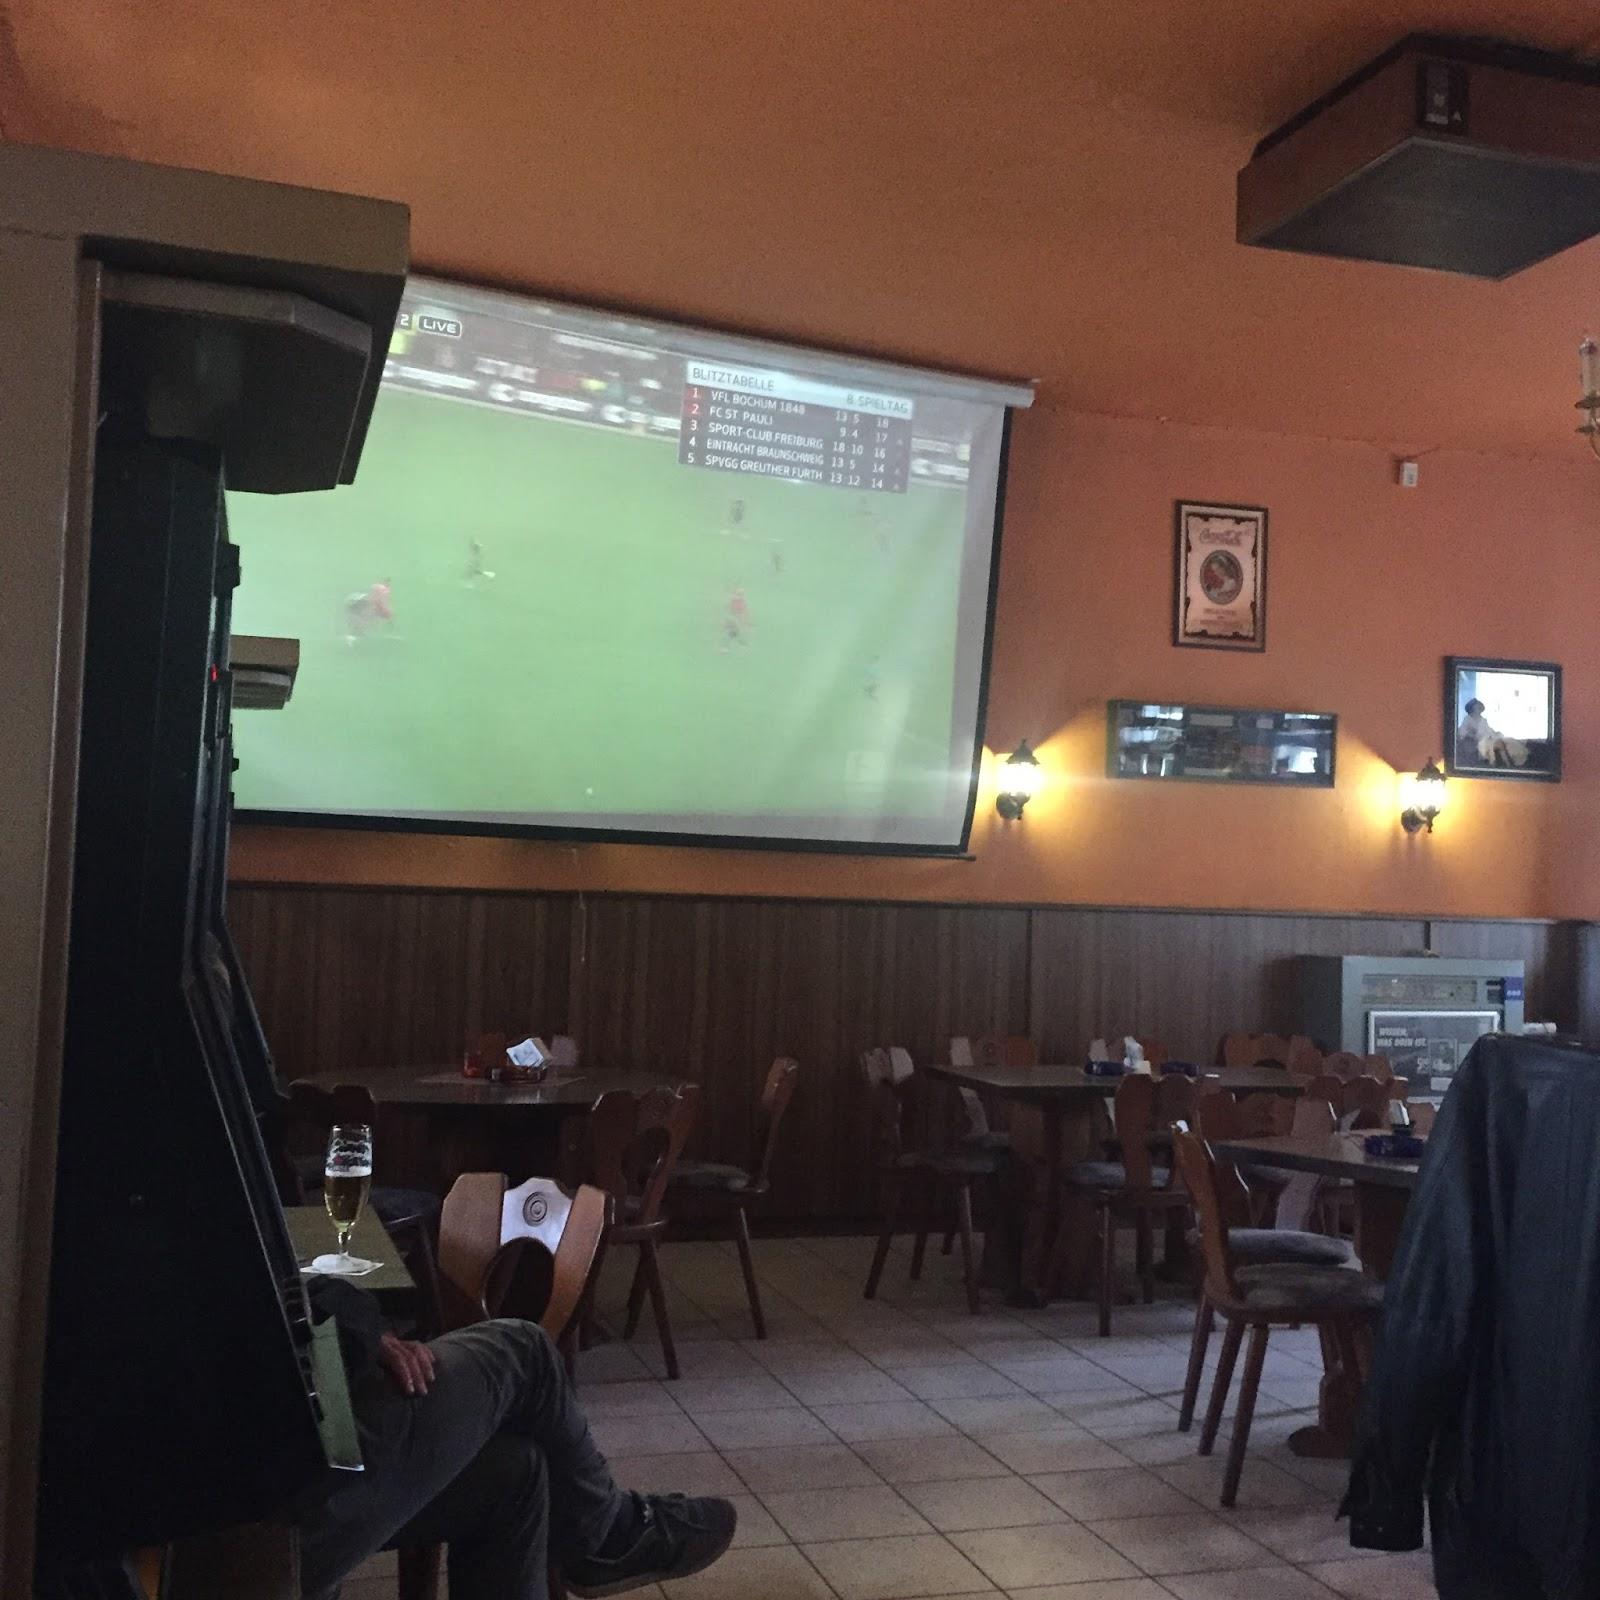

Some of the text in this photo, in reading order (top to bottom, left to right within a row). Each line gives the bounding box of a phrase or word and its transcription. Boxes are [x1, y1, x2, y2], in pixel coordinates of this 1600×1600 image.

[400, 313, 457, 334] 2 LIVE
[693, 367, 775, 392] BLITZTABELLE
[691, 403, 699, 415] 2
[710, 406, 722, 418] FC
[743, 411, 773, 425] PAULI
[840, 426, 847, 438] 9
[851, 429, 859, 440] 4
[876, 431, 888, 443] 17
[693, 387, 699, 399] 1
[711, 390, 730, 403] VFL
[733, 394, 777, 410] BOCHUM
[780, 401, 806, 415] 1848
[836, 410, 848, 422] 13
[853, 413, 860, 425] 5
[858, 396, 908, 414] SPIELTAG
[689, 436, 885, 474] 4 EINTRACHT BRAUNSCHWEIG 13 5 14
[690, 419, 886, 459] 3 SPORT-CLUB FREIBURG 18 10 16
[687, 452, 695, 464] 5
[705, 454, 739, 469] SPVGG
[740, 460, 791, 477] GREUTHER
[830, 472, 842, 484] 13
[847, 475, 861, 487] 12
[871, 478, 883, 490] 14
